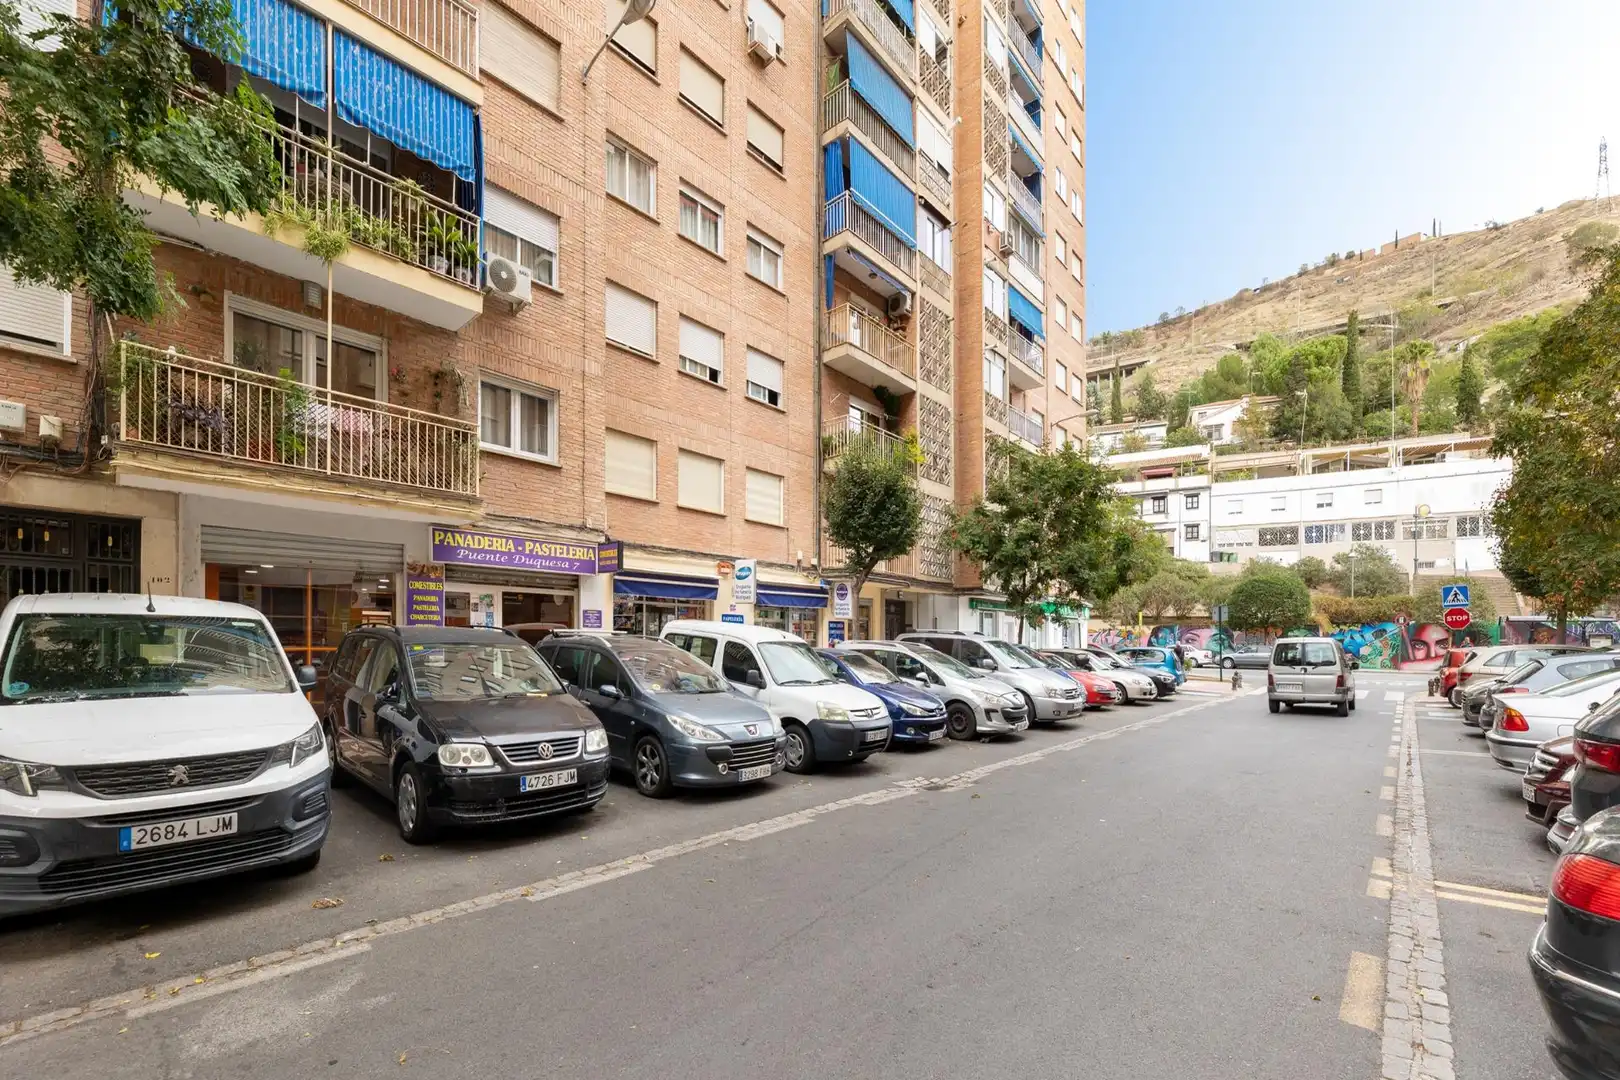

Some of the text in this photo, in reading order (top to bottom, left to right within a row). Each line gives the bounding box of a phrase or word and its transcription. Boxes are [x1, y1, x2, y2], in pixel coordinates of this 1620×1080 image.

[433, 530, 515, 553] PANADERIA
[524, 540, 596, 561] PASTELERIA
[456, 549, 580, 570] Puente Duquesa 7
[408, 580, 444, 590] COMESTIBLES
[413, 594, 439, 602] PANADERIA
[412, 604, 440, 612] PASTELERIA
[527, 770, 576, 788] 4726 FJM
[135, 815, 233, 845] 2684 LJM
